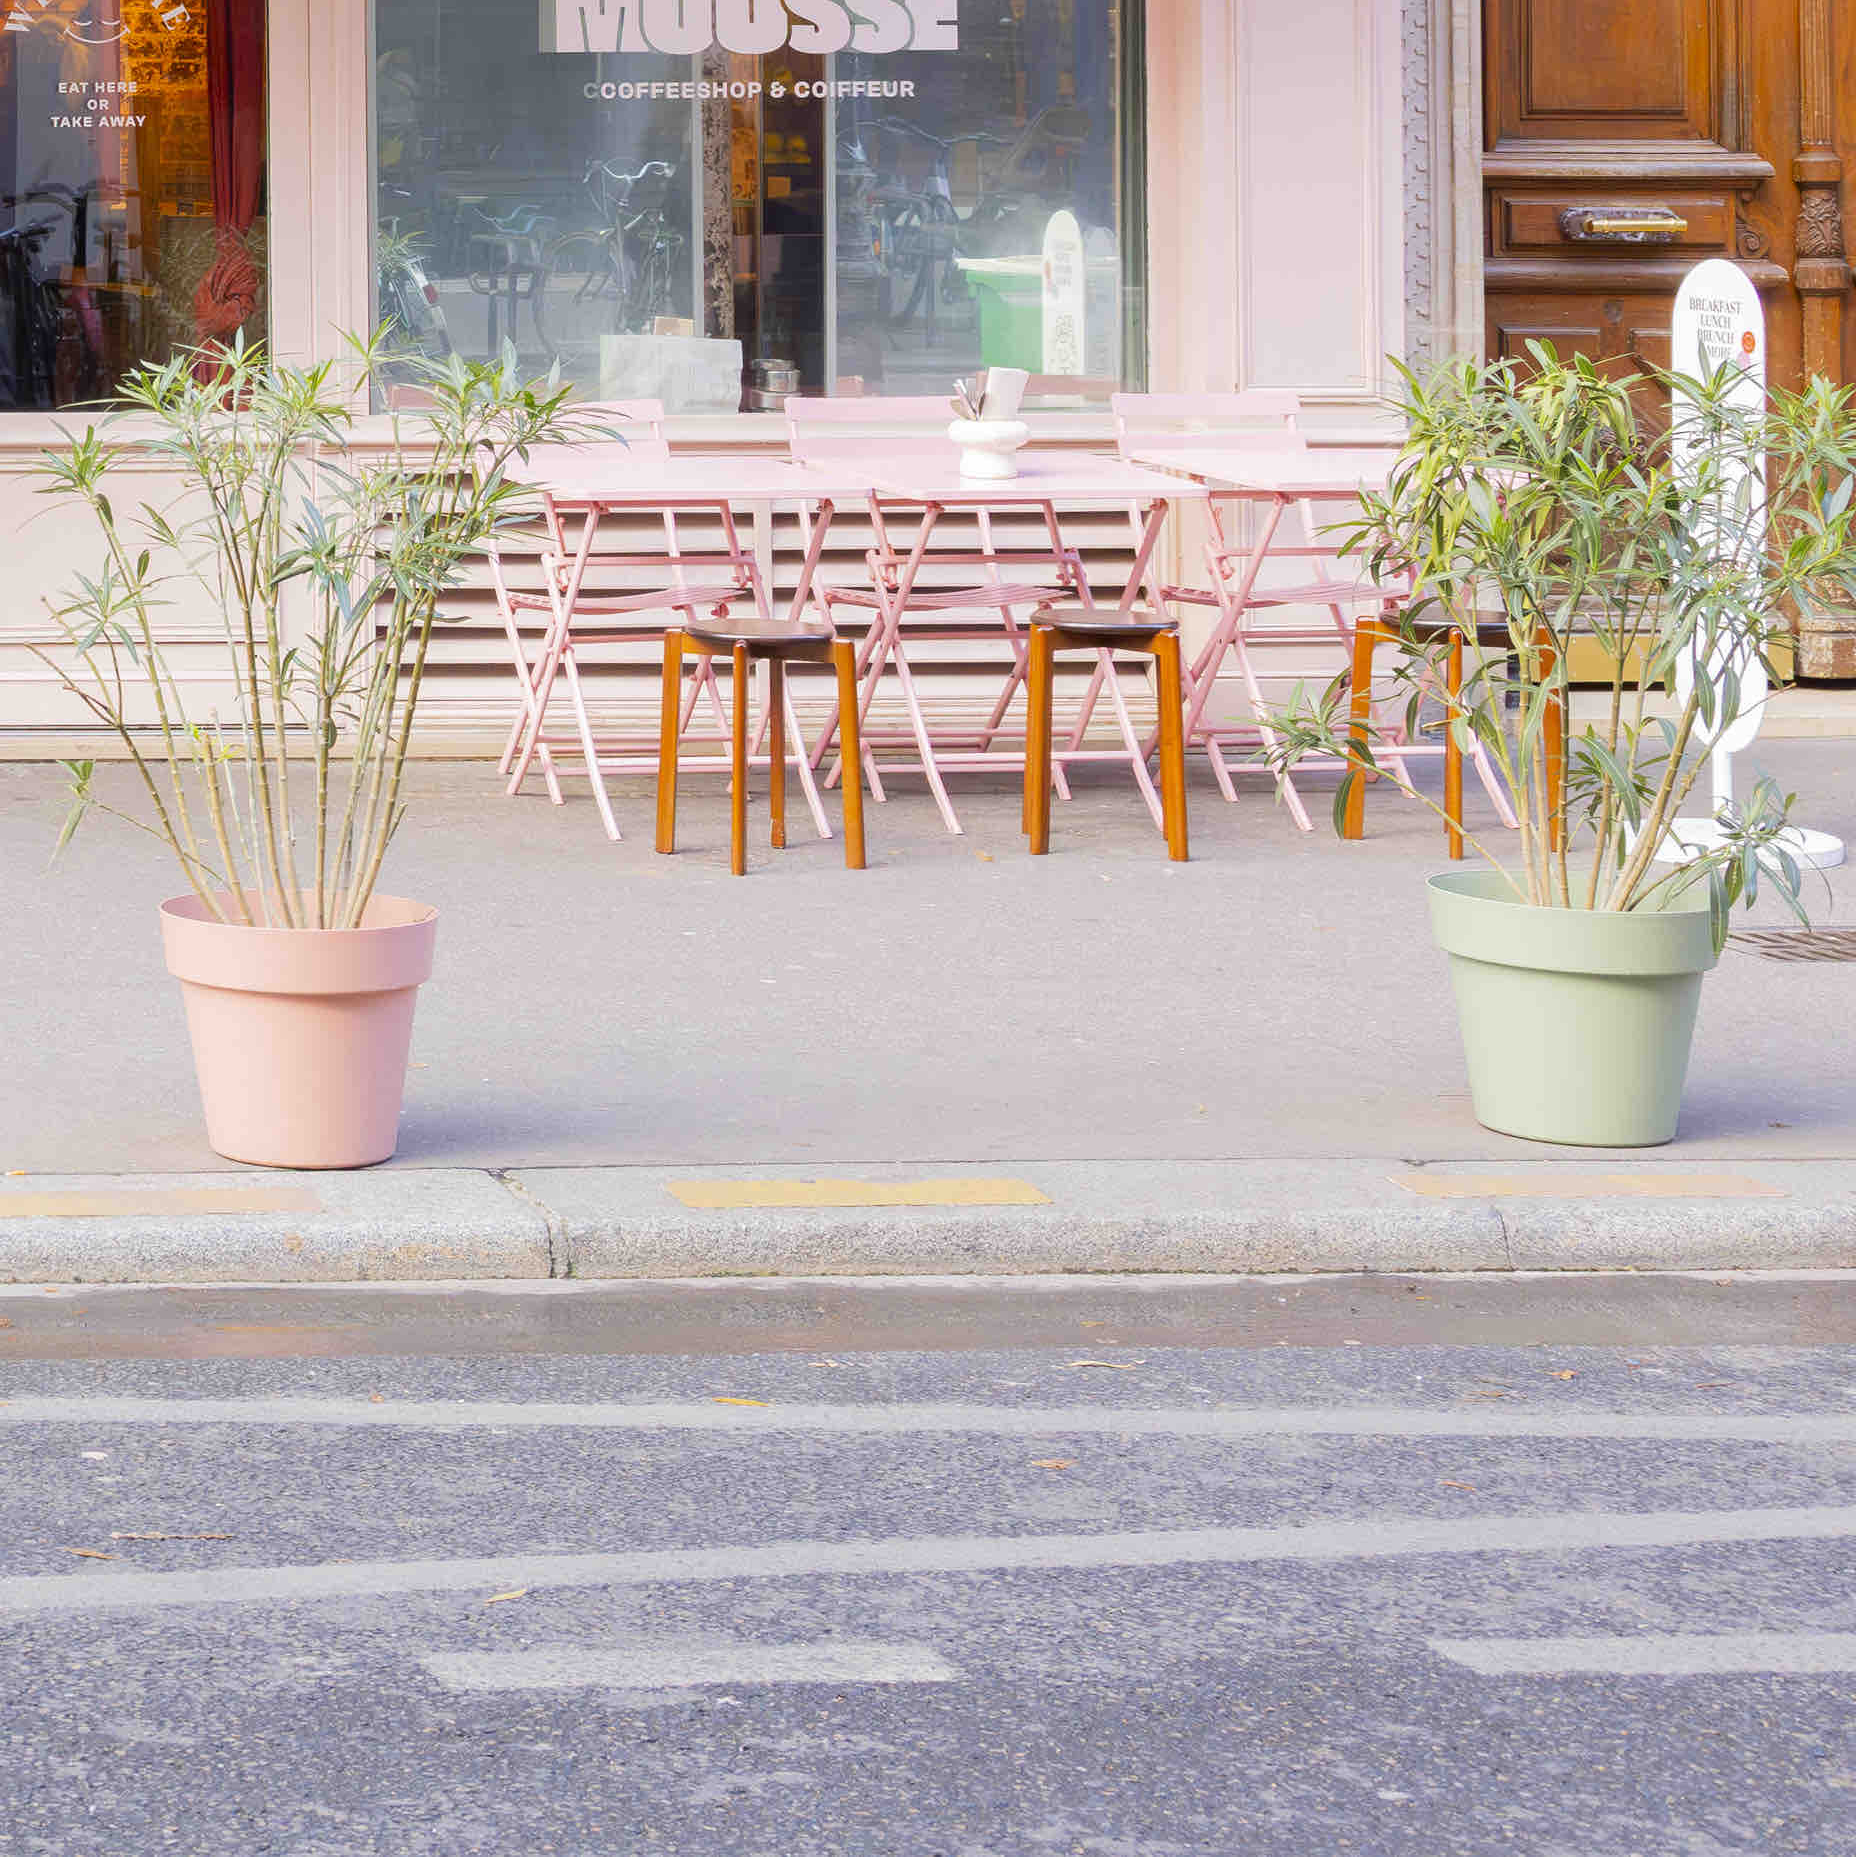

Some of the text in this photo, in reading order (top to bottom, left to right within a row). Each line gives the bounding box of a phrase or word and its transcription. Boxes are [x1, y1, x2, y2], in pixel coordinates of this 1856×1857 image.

[58, 82, 138, 93] EAT HERE
[600, 80, 916, 99] COFFEESHOP & COIFFEUR
[87, 99, 109, 110] OR
[51, 116, 147, 128] TAKE AWAY
[1689, 297, 1742, 314] BREAKFAST
[1700, 314, 1732, 329] LUNCH
[1697, 328, 1735, 344] BRUNCH
[1707, 345, 1732, 359] MORE
